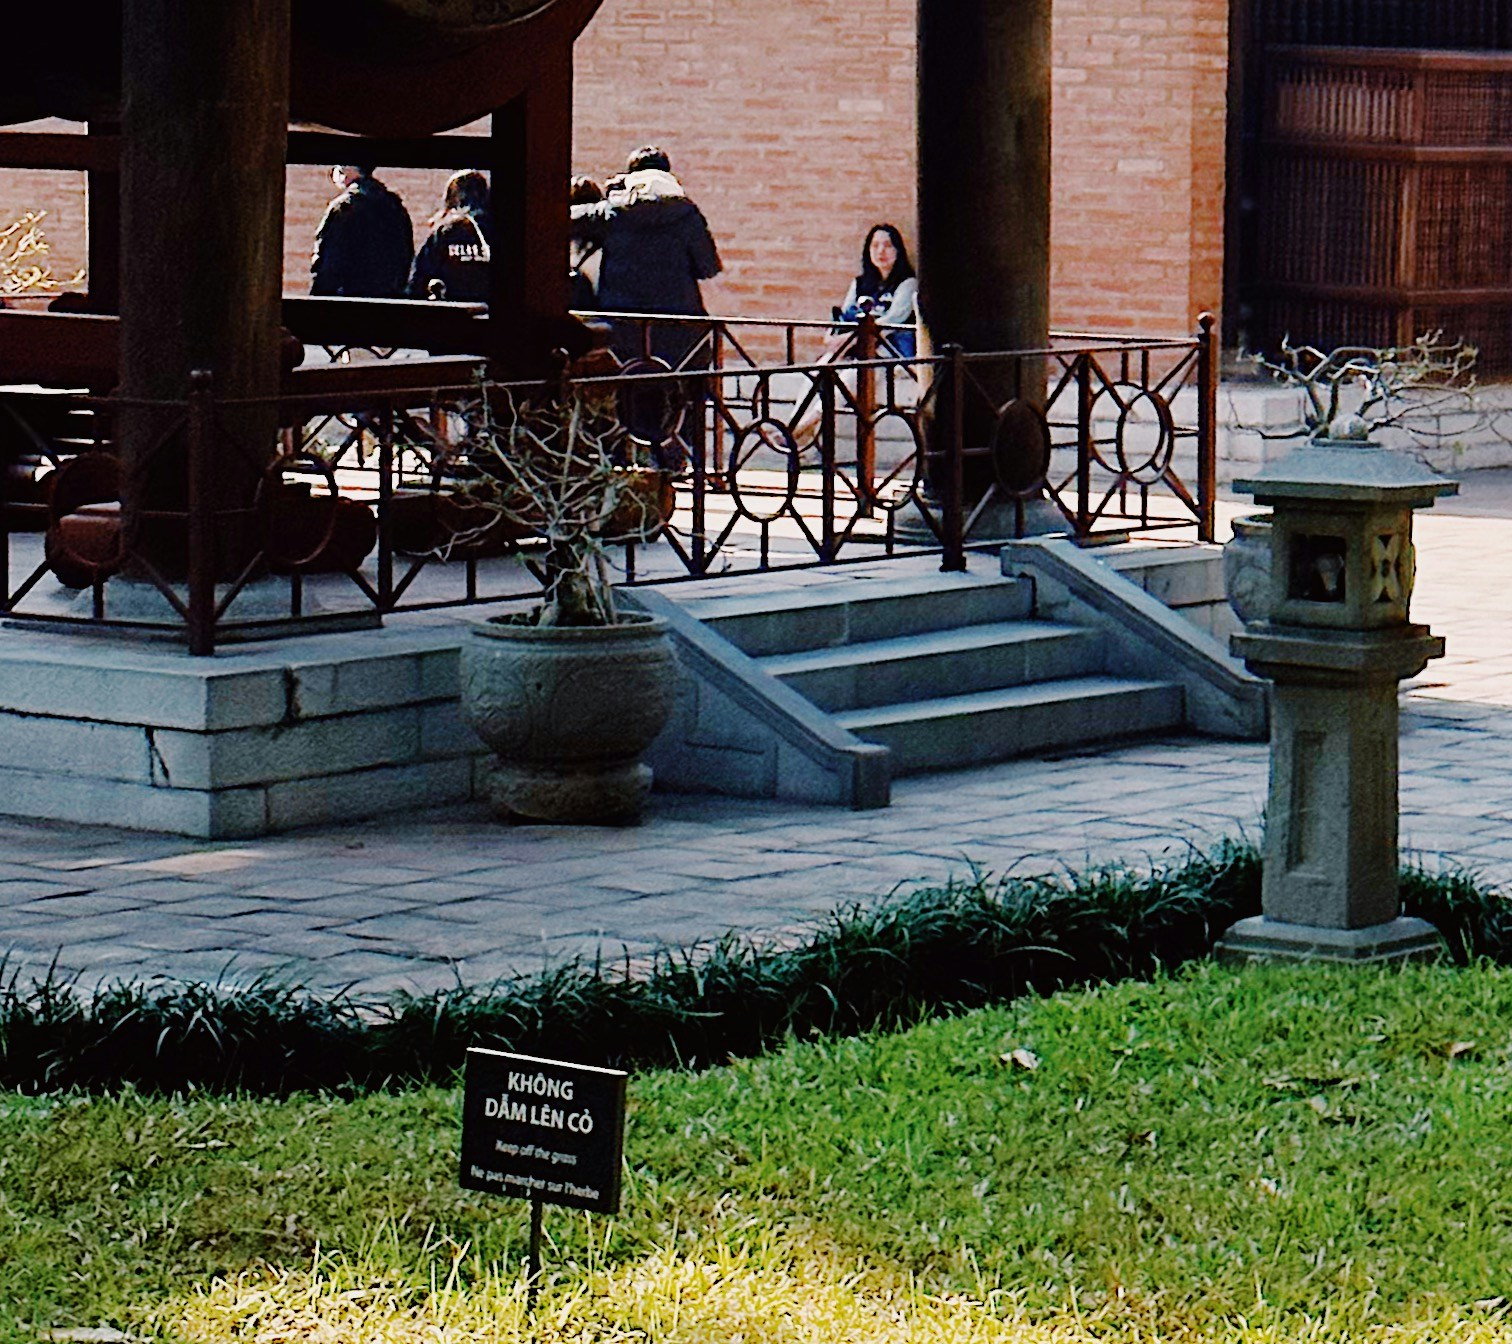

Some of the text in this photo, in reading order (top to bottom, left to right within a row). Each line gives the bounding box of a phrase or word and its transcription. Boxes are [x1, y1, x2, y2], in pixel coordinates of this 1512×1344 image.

[508, 1071, 574, 1101] KHÔNG
[530, 1104, 564, 1130] LÊN
[567, 1108, 594, 1134] CỎ
[520, 1144, 535, 1156] off
[534, 1147, 551, 1160] the
